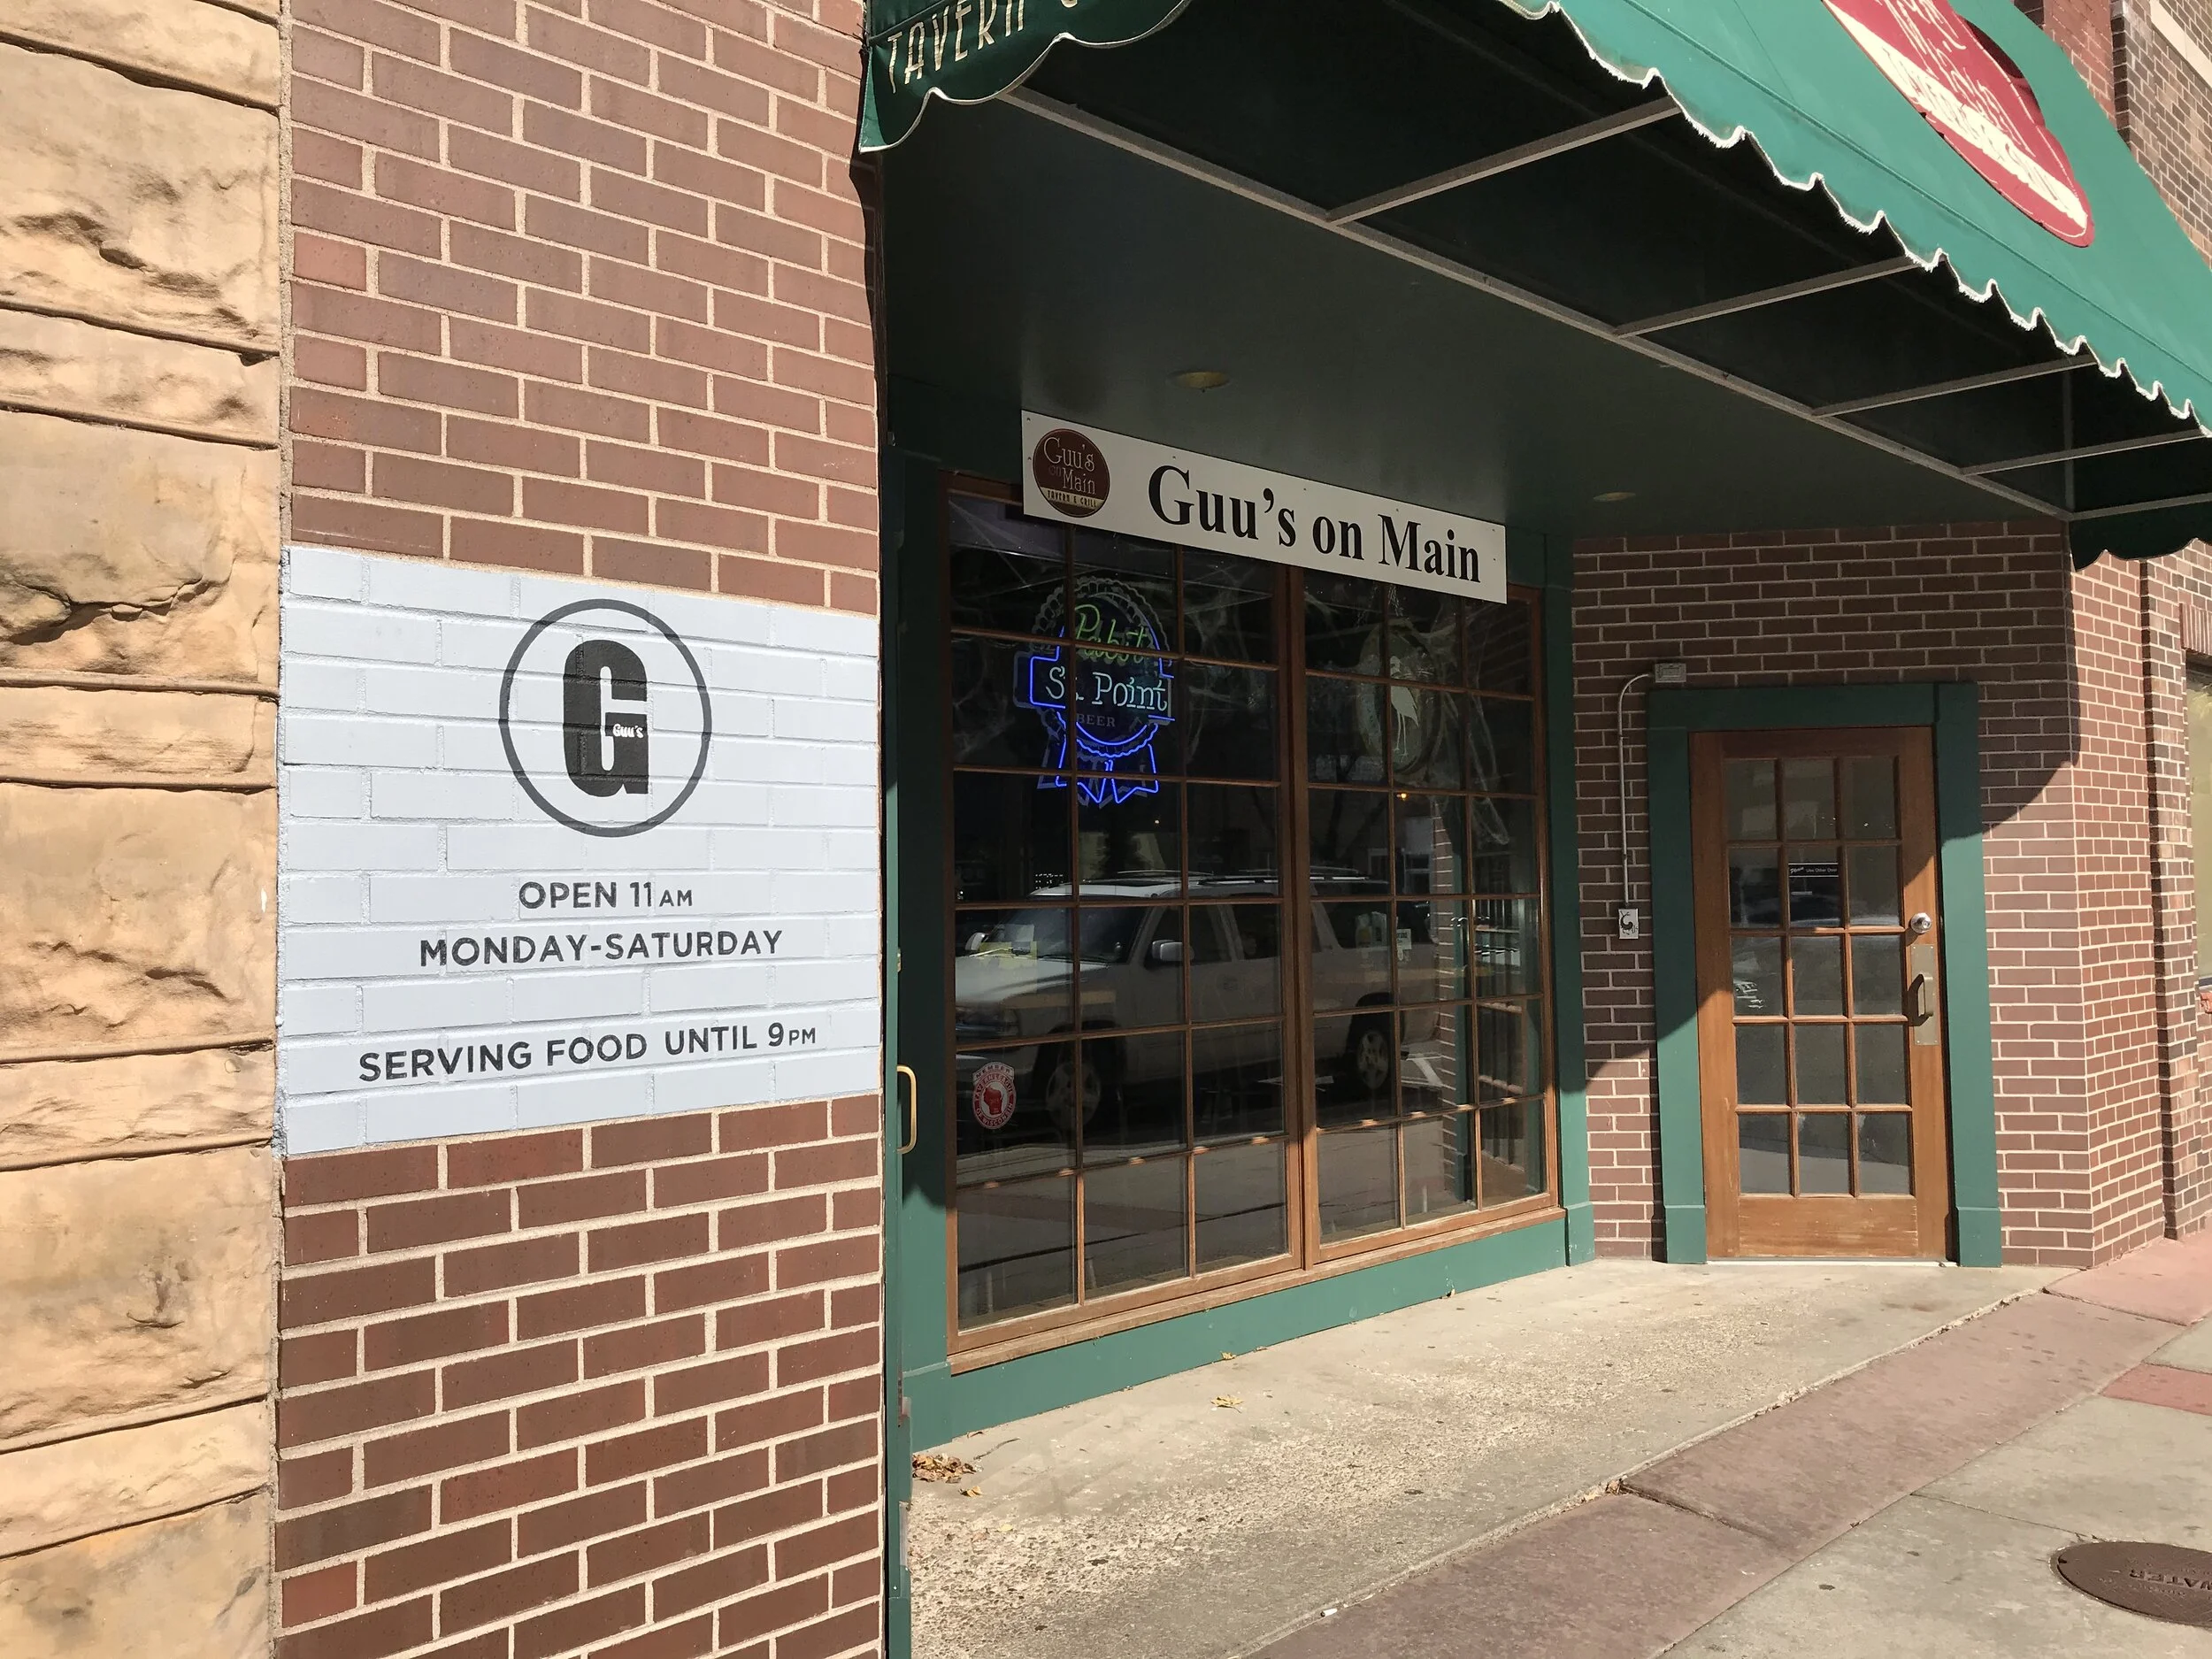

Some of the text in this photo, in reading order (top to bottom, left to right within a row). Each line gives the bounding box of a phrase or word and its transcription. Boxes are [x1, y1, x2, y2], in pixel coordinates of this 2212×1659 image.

[887, 0, 1025, 94] TAVERN
[1043, 437, 1094, 472] Guu's
[1062, 467, 1097, 495] Main
[1148, 464, 1481, 583] Guu's on Main
[1091, 671, 1168, 712] Point
[562, 638, 649, 797] G
[611, 722, 645, 740] Guu's
[1076, 712, 1117, 728] BEER
[518, 880, 618, 910] OPEN
[419, 930, 783, 968] MONDAY-SATURDAY
[358, 1041, 533, 1083] SERVING
[547, 1033, 649, 1067] FOOD
[664, 1025, 759, 1056] UNTIL
